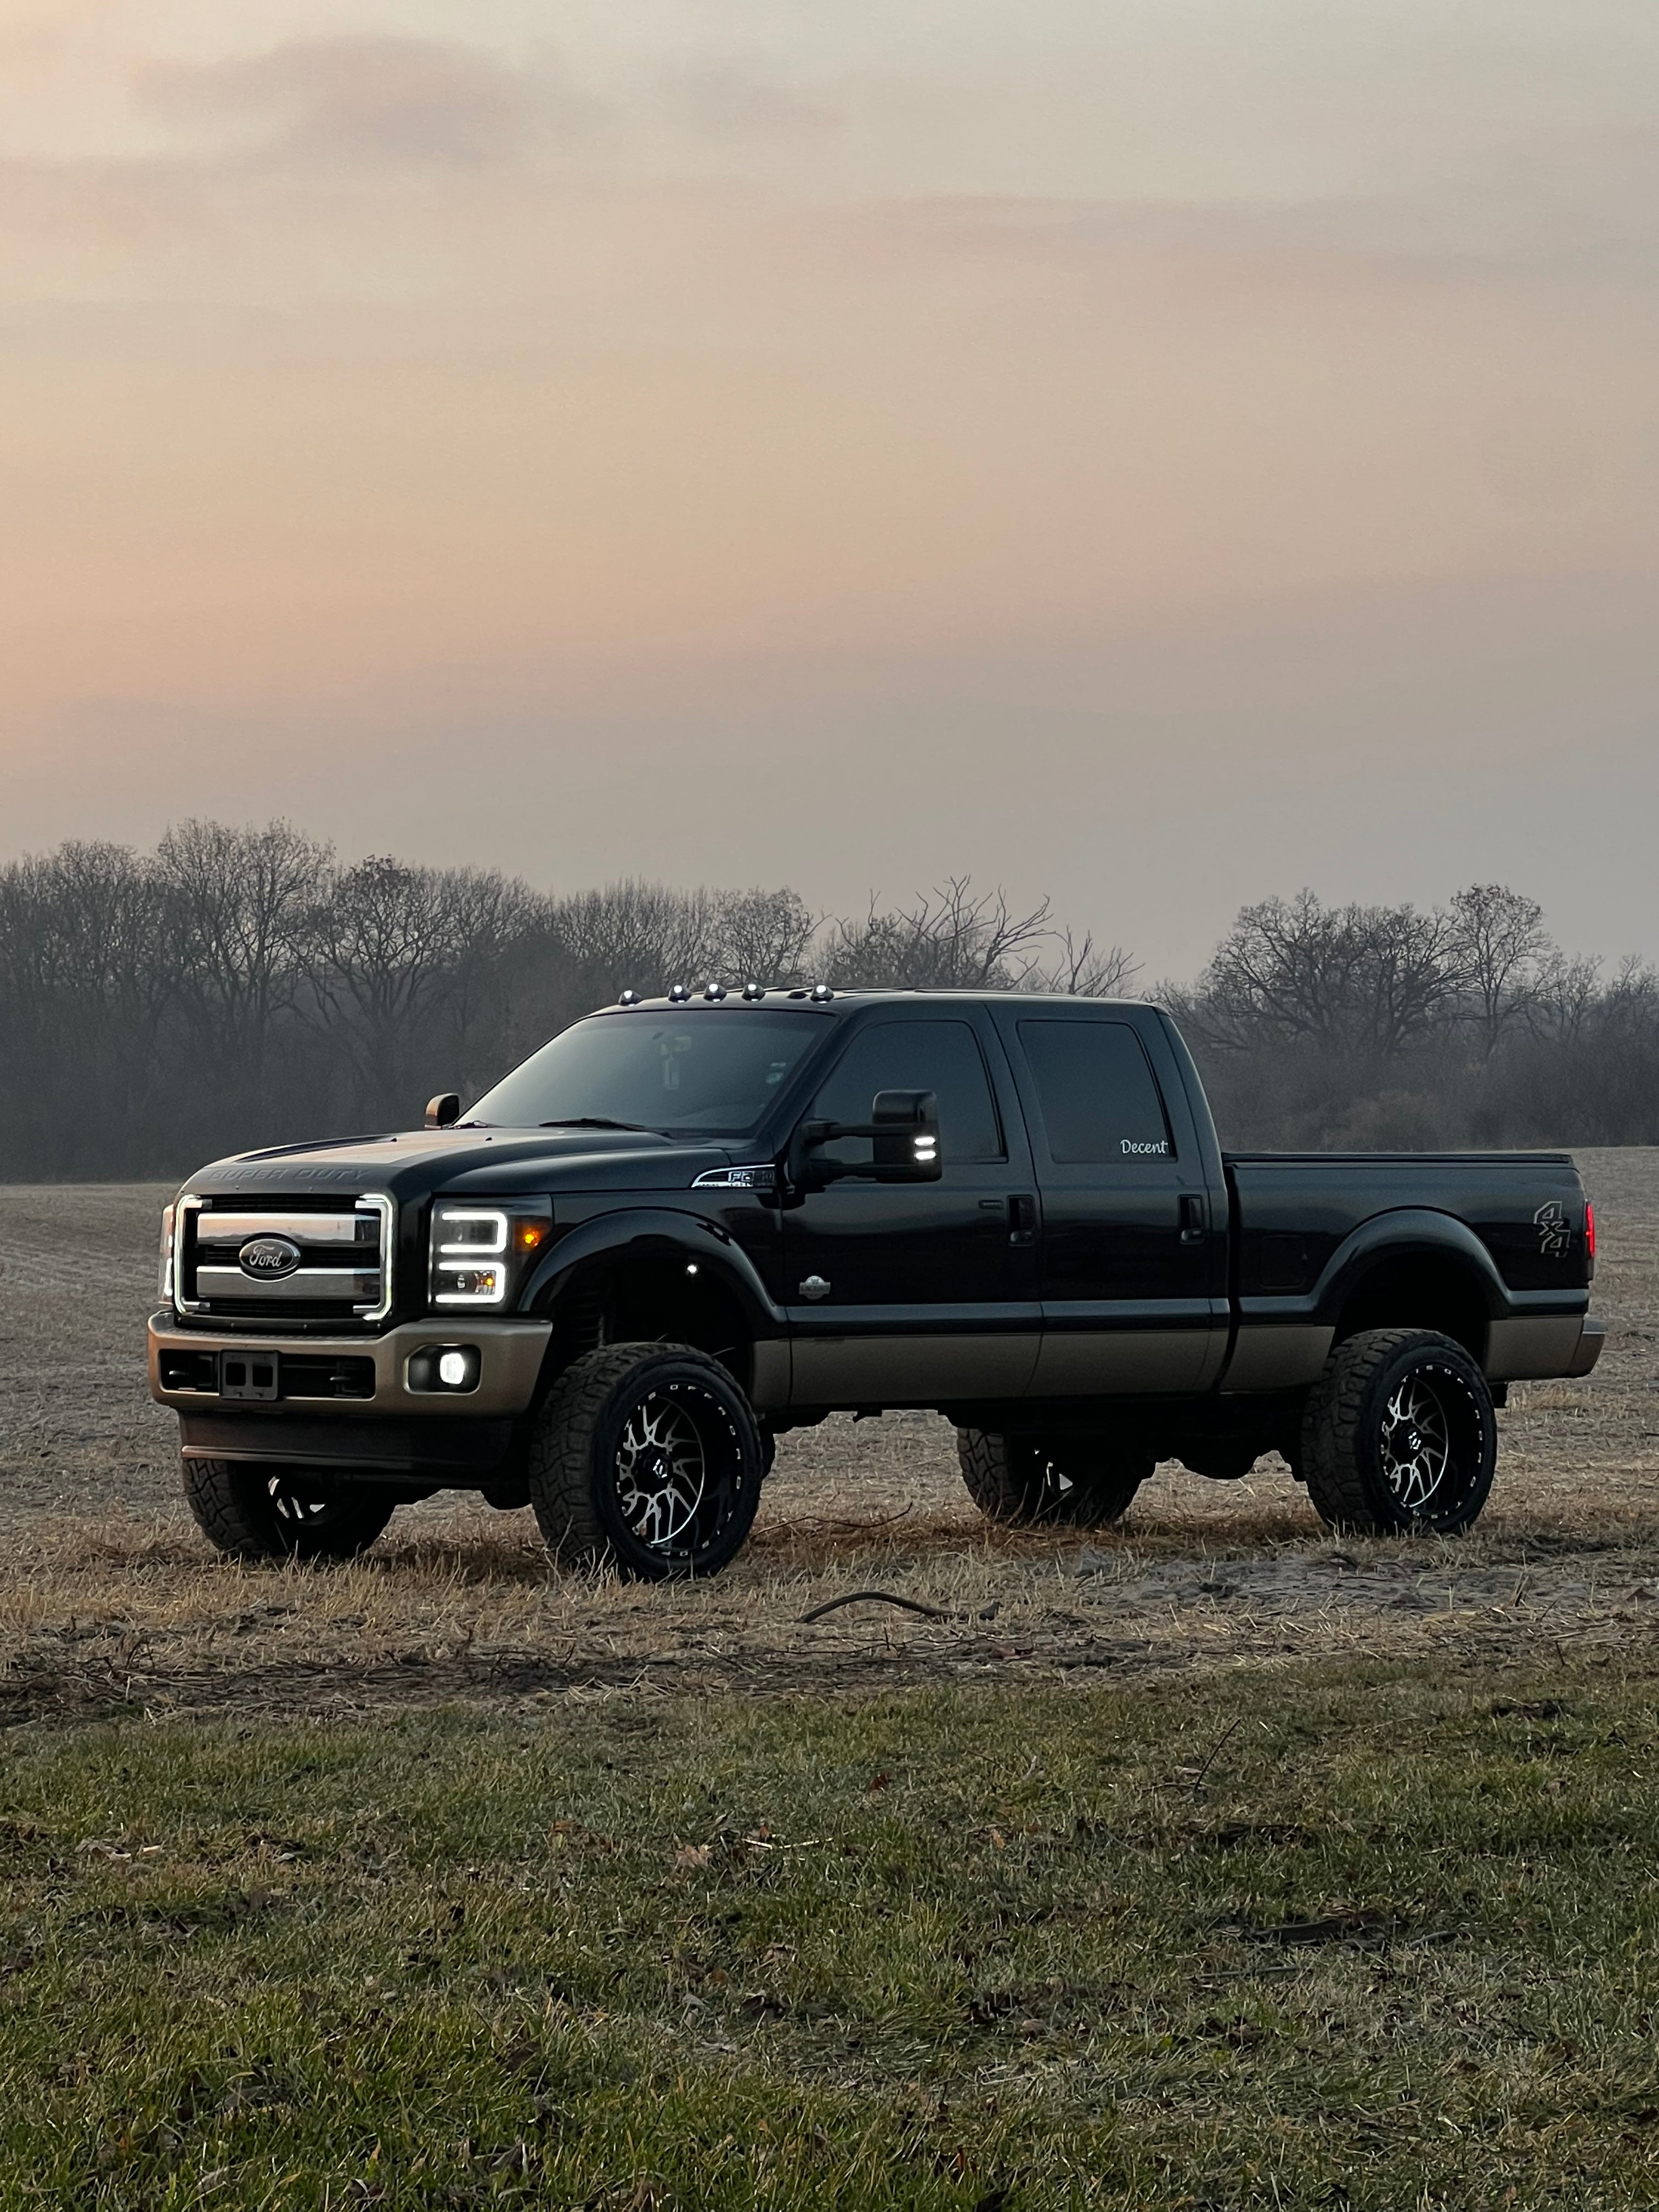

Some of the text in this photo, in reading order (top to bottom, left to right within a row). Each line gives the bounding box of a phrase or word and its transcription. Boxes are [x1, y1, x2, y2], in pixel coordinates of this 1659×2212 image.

[1120, 1139, 1168, 1154] Decent
[208, 1167, 370, 1181] SUPER DUTY
[249, 1244, 283, 1268] Ford
